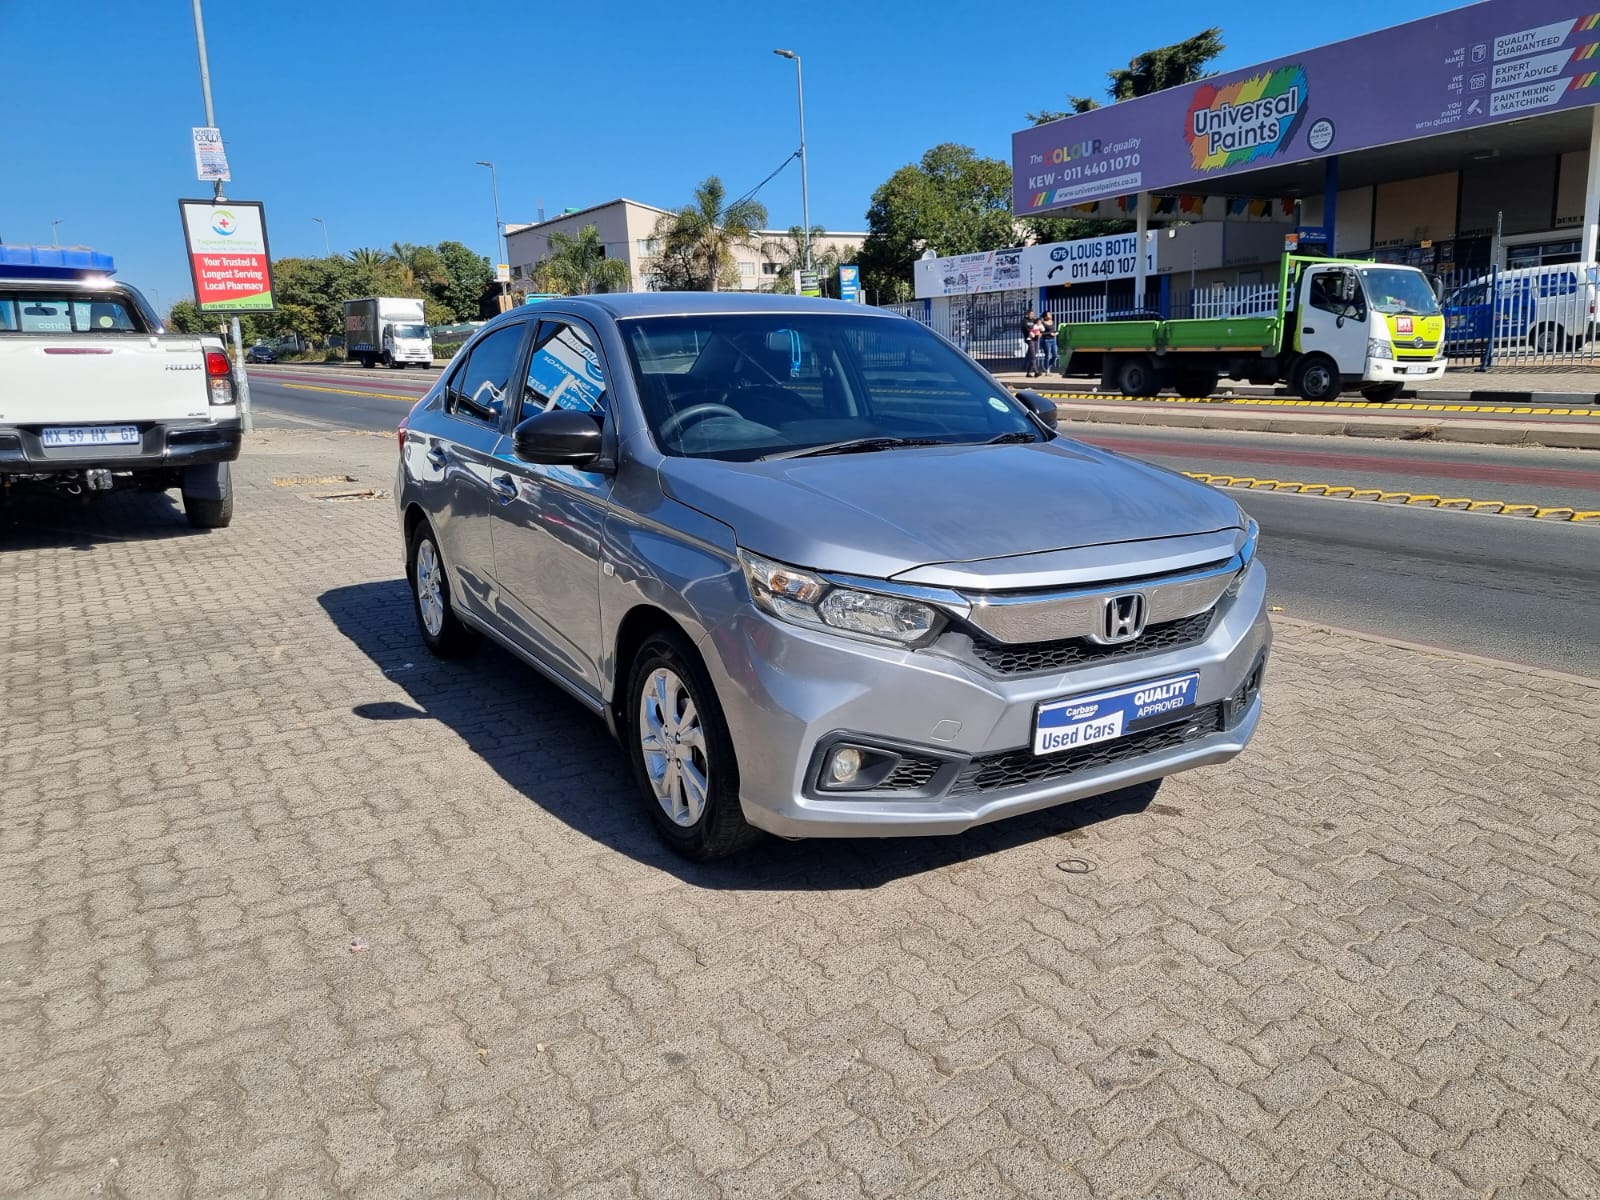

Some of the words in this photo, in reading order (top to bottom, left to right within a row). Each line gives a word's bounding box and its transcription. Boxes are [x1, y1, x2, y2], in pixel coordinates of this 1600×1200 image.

[1497, 32, 1536, 48] QUALITY
[1497, 36, 1560, 56] GUARANTEED
[1445, 55, 1465, 64] MAKE
[1495, 73, 1522, 85] PAINT
[1523, 65, 1559, 79] ADVICE
[1496, 62, 1530, 76] EXPERT
[1448, 82, 1462, 90] SELL
[1494, 92, 1521, 103] PAINT
[1522, 84, 1556, 97] MIXING
[1194, 87, 1297, 134] Universal
[1448, 101, 1462, 109] YOU
[1500, 95, 1549, 111] MATCHING
[1442, 109, 1462, 117] PAINT
[1416, 121, 1432, 129] WITH
[1433, 115, 1462, 127] QUALITY
[1209, 120, 1279, 154] Paints
[1030, 154, 1043, 165] The
[1044, 139, 1102, 167] COLOUR
[1103, 143, 1113, 154] of
[1113, 137, 1142, 154] quality
[1028, 172, 1056, 190] KEW
[1064, 166, 1082, 181] 011
[1084, 161, 1108, 177] 440
[1109, 153, 1140, 172] 1070
[1058, 177, 1138, 198] www.universalpaints.co.za
[1052, 249, 1067, 259] 575
[1070, 242, 1102, 260] LOUIS
[1106, 238, 1138, 257] BOTH
[203, 257, 221, 266] Your
[221, 257, 250, 266] Trusted
[251, 257, 258, 266] &
[1071, 262, 1088, 278] 011
[1092, 259, 1115, 276] 440
[202, 269, 233, 280] Longest
[234, 270, 263, 280] Serving
[205, 281, 226, 290] Local
[226, 282, 264, 292] Pharmacy
[44, 430, 62, 443] MX
[69, 429, 84, 443] 59
[91, 428, 108, 442] HX
[120, 427, 137, 441] GP
[1134, 680, 1190, 706] QUALITY
[1066, 704, 1099, 717] Carbase
[1137, 697, 1184, 718] APPROVED
[1042, 728, 1078, 750] Used
[1083, 722, 1115, 741] Cars
